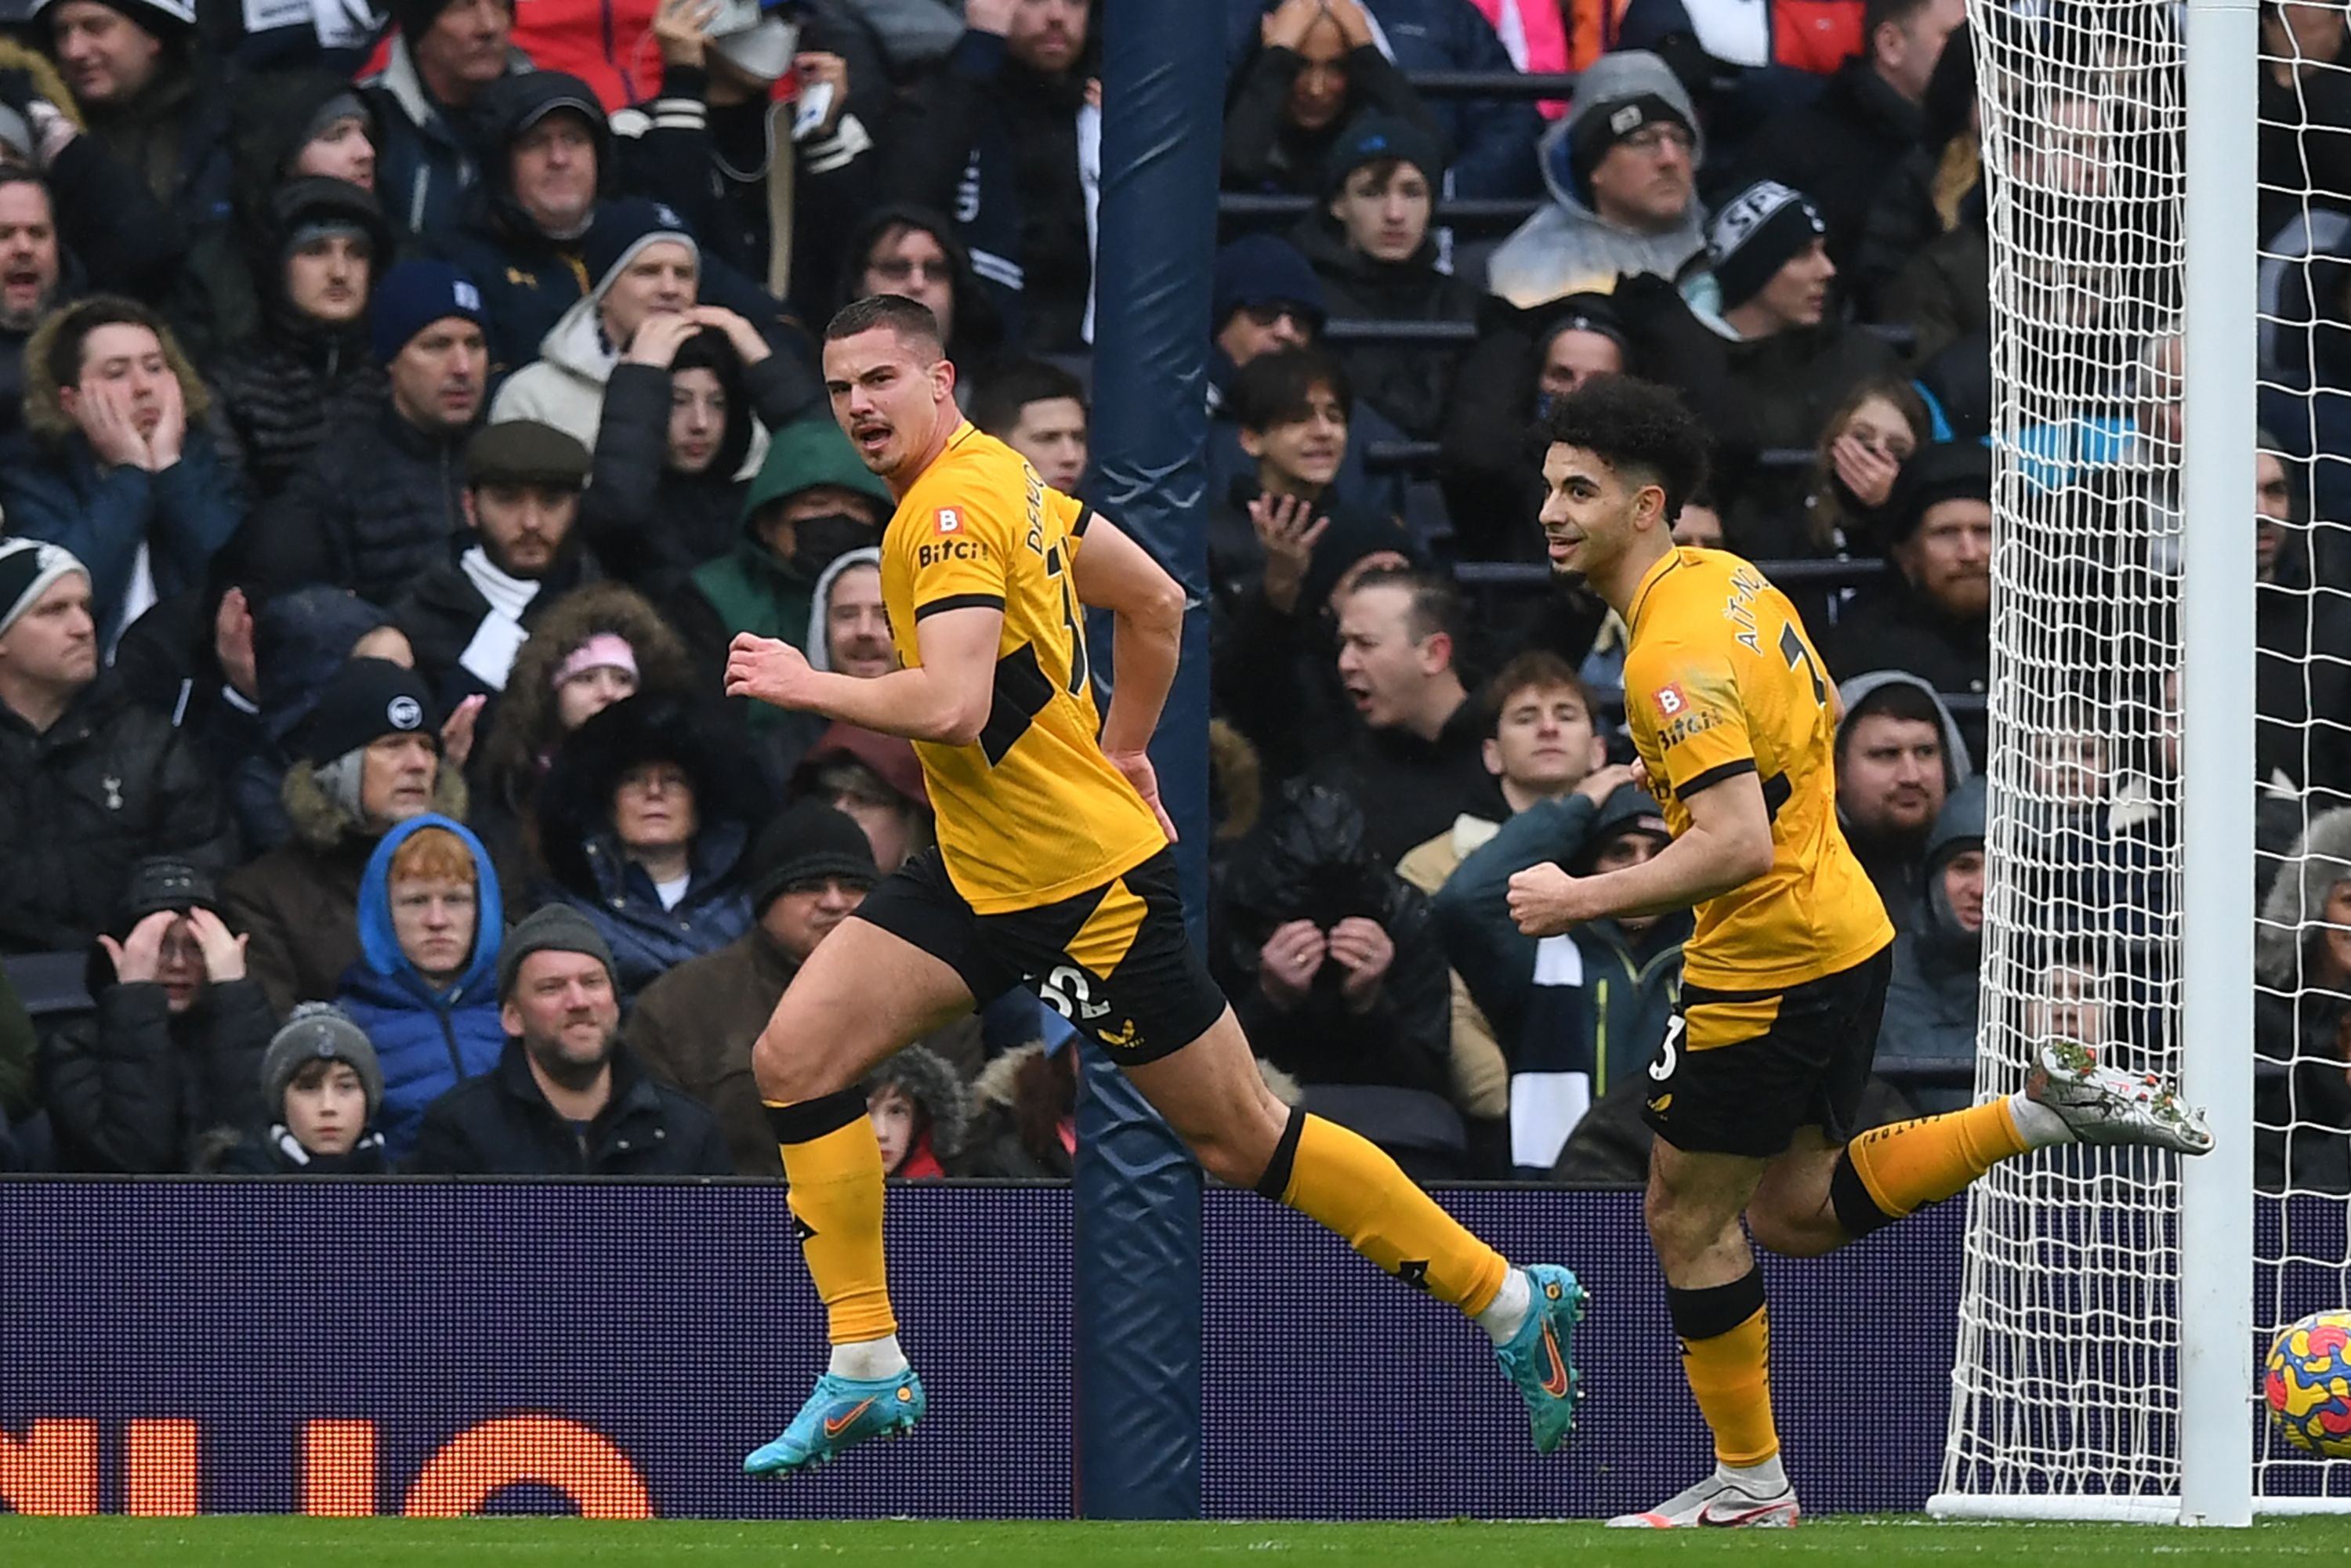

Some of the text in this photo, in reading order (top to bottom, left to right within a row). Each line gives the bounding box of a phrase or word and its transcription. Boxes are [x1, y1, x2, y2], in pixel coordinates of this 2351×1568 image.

[939, 509, 958, 532] B
[1658, 690, 1681, 714] B
[1649, 1014, 1686, 1081] 3
